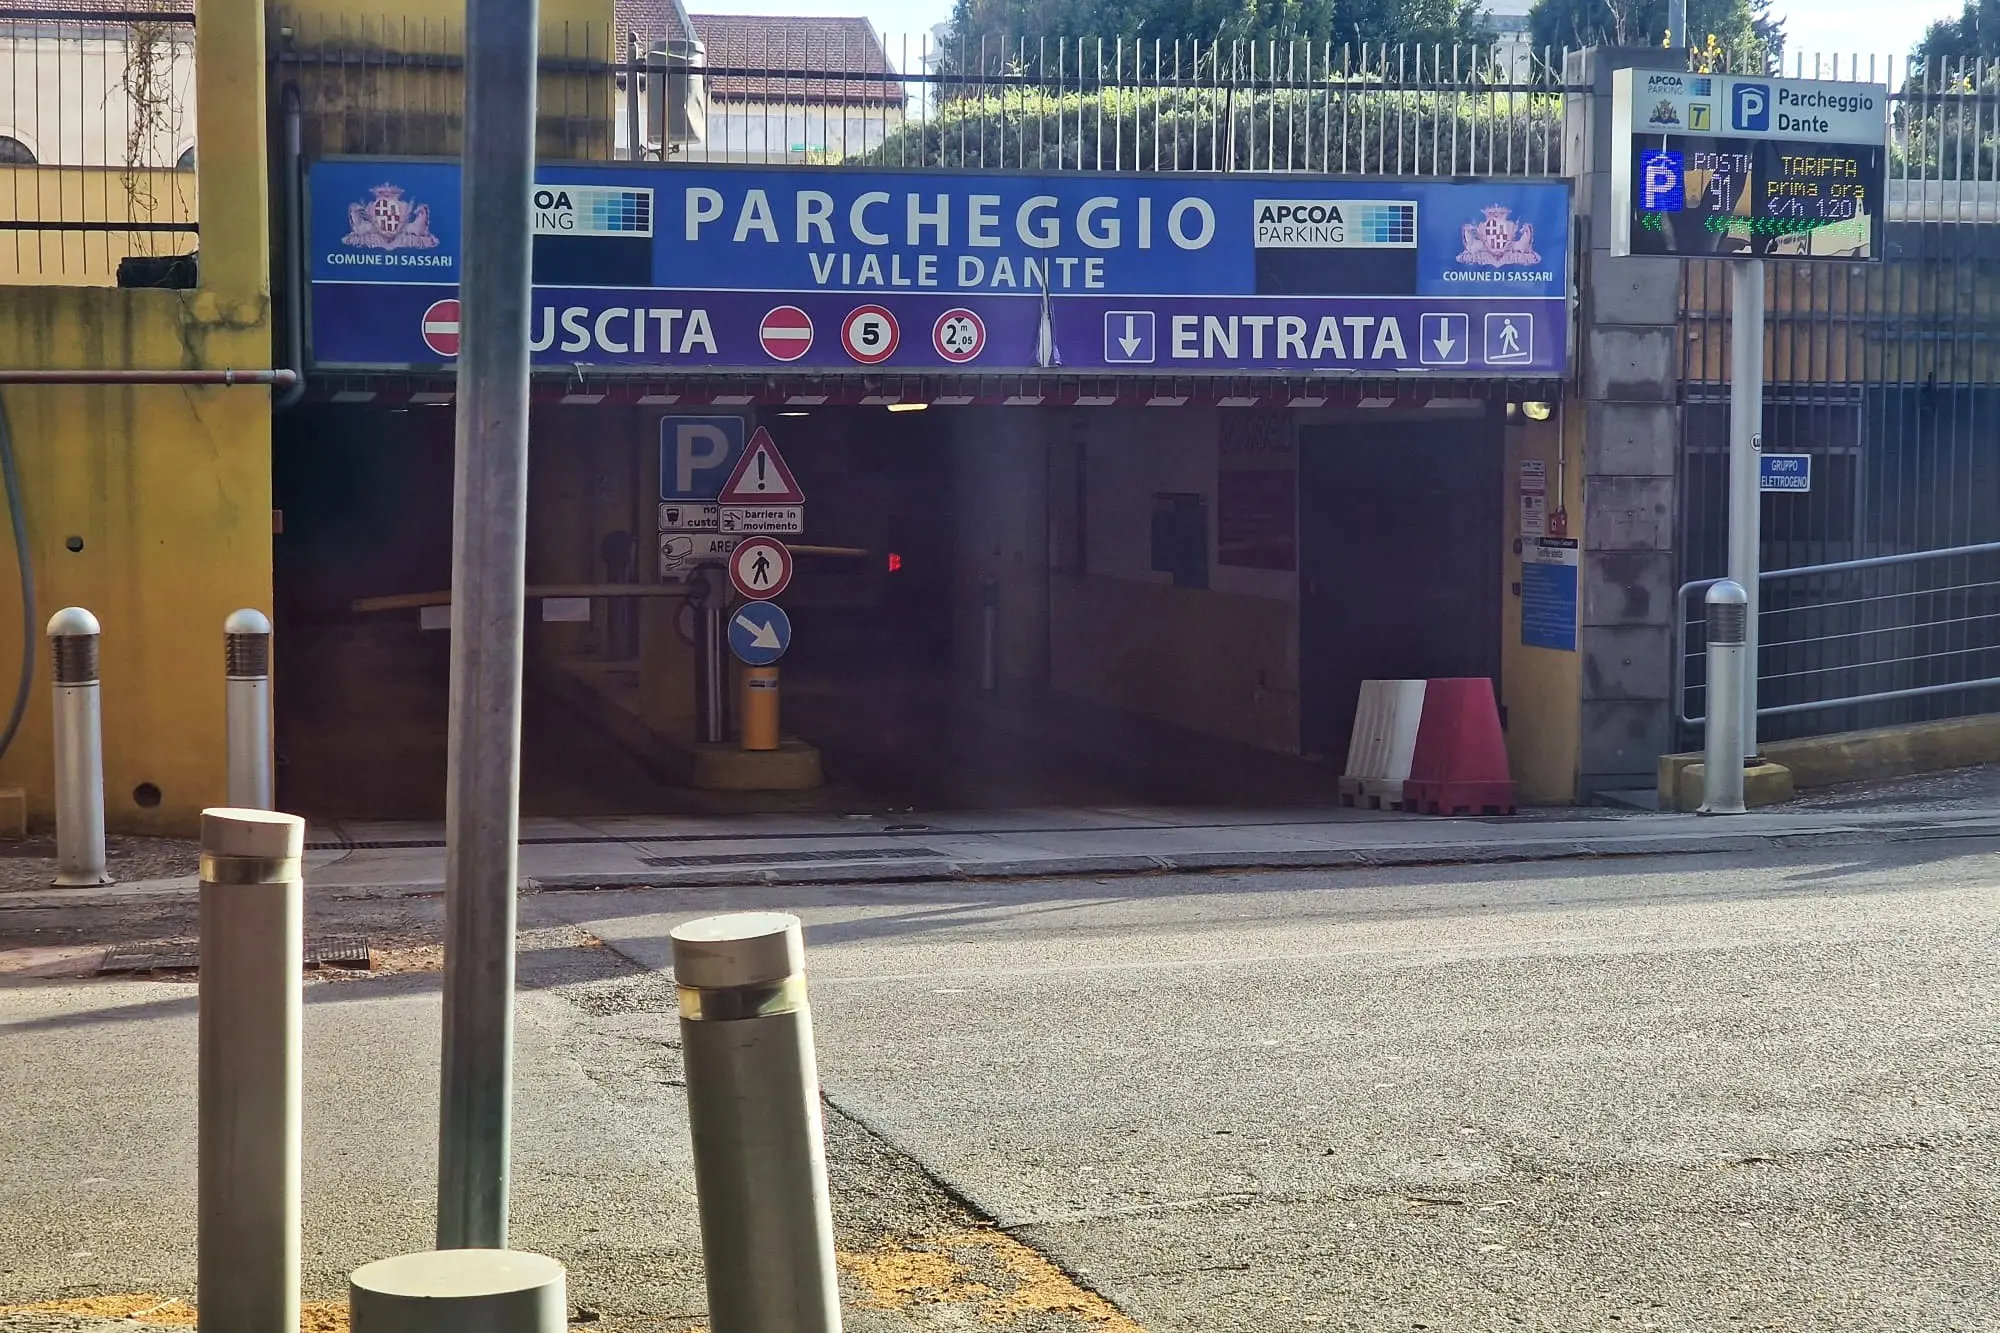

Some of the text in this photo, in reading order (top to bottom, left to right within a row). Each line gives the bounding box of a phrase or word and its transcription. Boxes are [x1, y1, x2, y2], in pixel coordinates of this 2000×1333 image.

[1648, 76, 1683, 86] APCOA
[1778, 88, 1873, 111] Parcheggio
[1778, 114, 1829, 132] Dante
[1694, 152, 1749, 173] POSTI
[1781, 156, 1857, 177] TARIFFA
[1710, 174, 1731, 211] 91
[1767, 177, 1865, 199] prima ora
[685, 187, 1216, 250] PARCHEGGIO
[1259, 205, 1344, 225] APCOA
[1259, 226, 1344, 243] PARKING
[327, 253, 452, 267] COMUNE DI SASSARI
[809, 253, 1105, 289] VIALE DANTE
[1442, 270, 1553, 283] COMUNE DI SASSARI
[862, 323, 879, 345] 5
[1172, 315, 1407, 360] ENTRATA
[1771, 460, 1799, 471] GRUPPO
[1761, 475, 1807, 488] ELETTROGENO
[745, 510, 796, 519] barriera in
[743, 522, 798, 531] movimento
